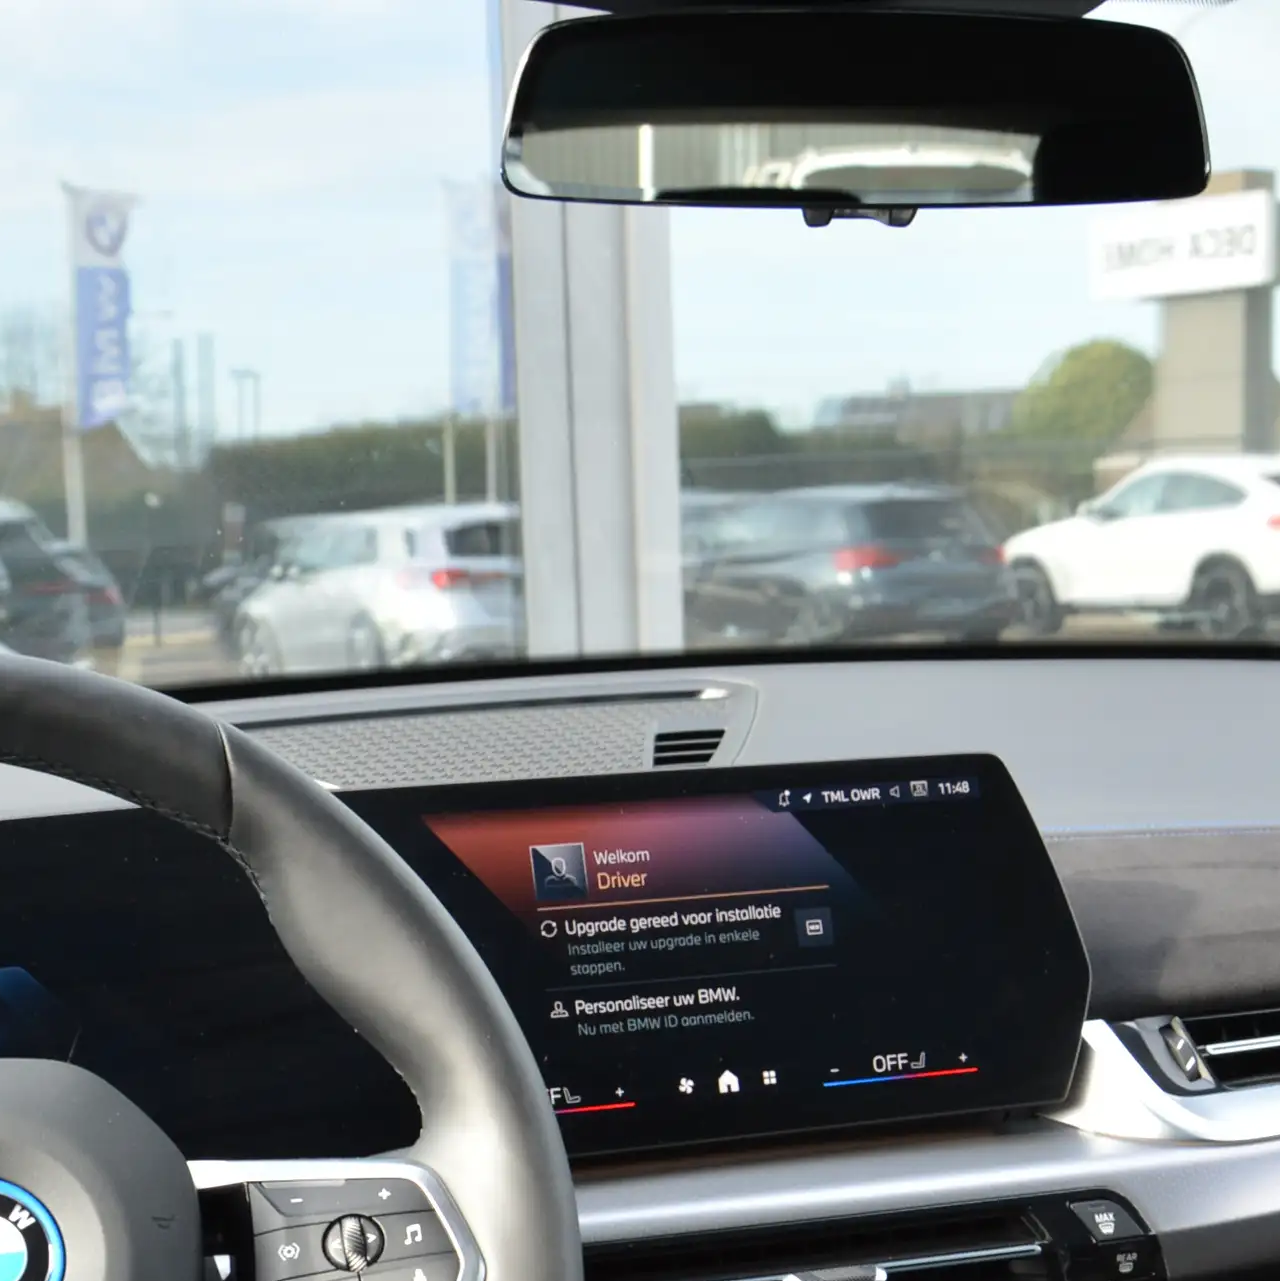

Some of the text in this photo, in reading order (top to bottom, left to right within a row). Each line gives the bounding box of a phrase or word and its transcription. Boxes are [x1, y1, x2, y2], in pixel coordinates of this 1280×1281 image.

[821, 787, 881, 803] TML OWR
[937, 780, 971, 796] 11:48
[593, 848, 651, 866] Welkom
[596, 871, 648, 890] Driver
[564, 903, 782, 938] Upgrade gereed voor installatie
[567, 928, 761, 956] Installeer uw upgrade in enkele
[570, 960, 626, 977] stappen.
[574, 986, 741, 1016] Personaliseer uw BMW.
[577, 1009, 756, 1036] Nu met BMW ID aanmelden.
[872, 1052, 909, 1073] OFF
[1093, 1211, 1116, 1223] MAX
